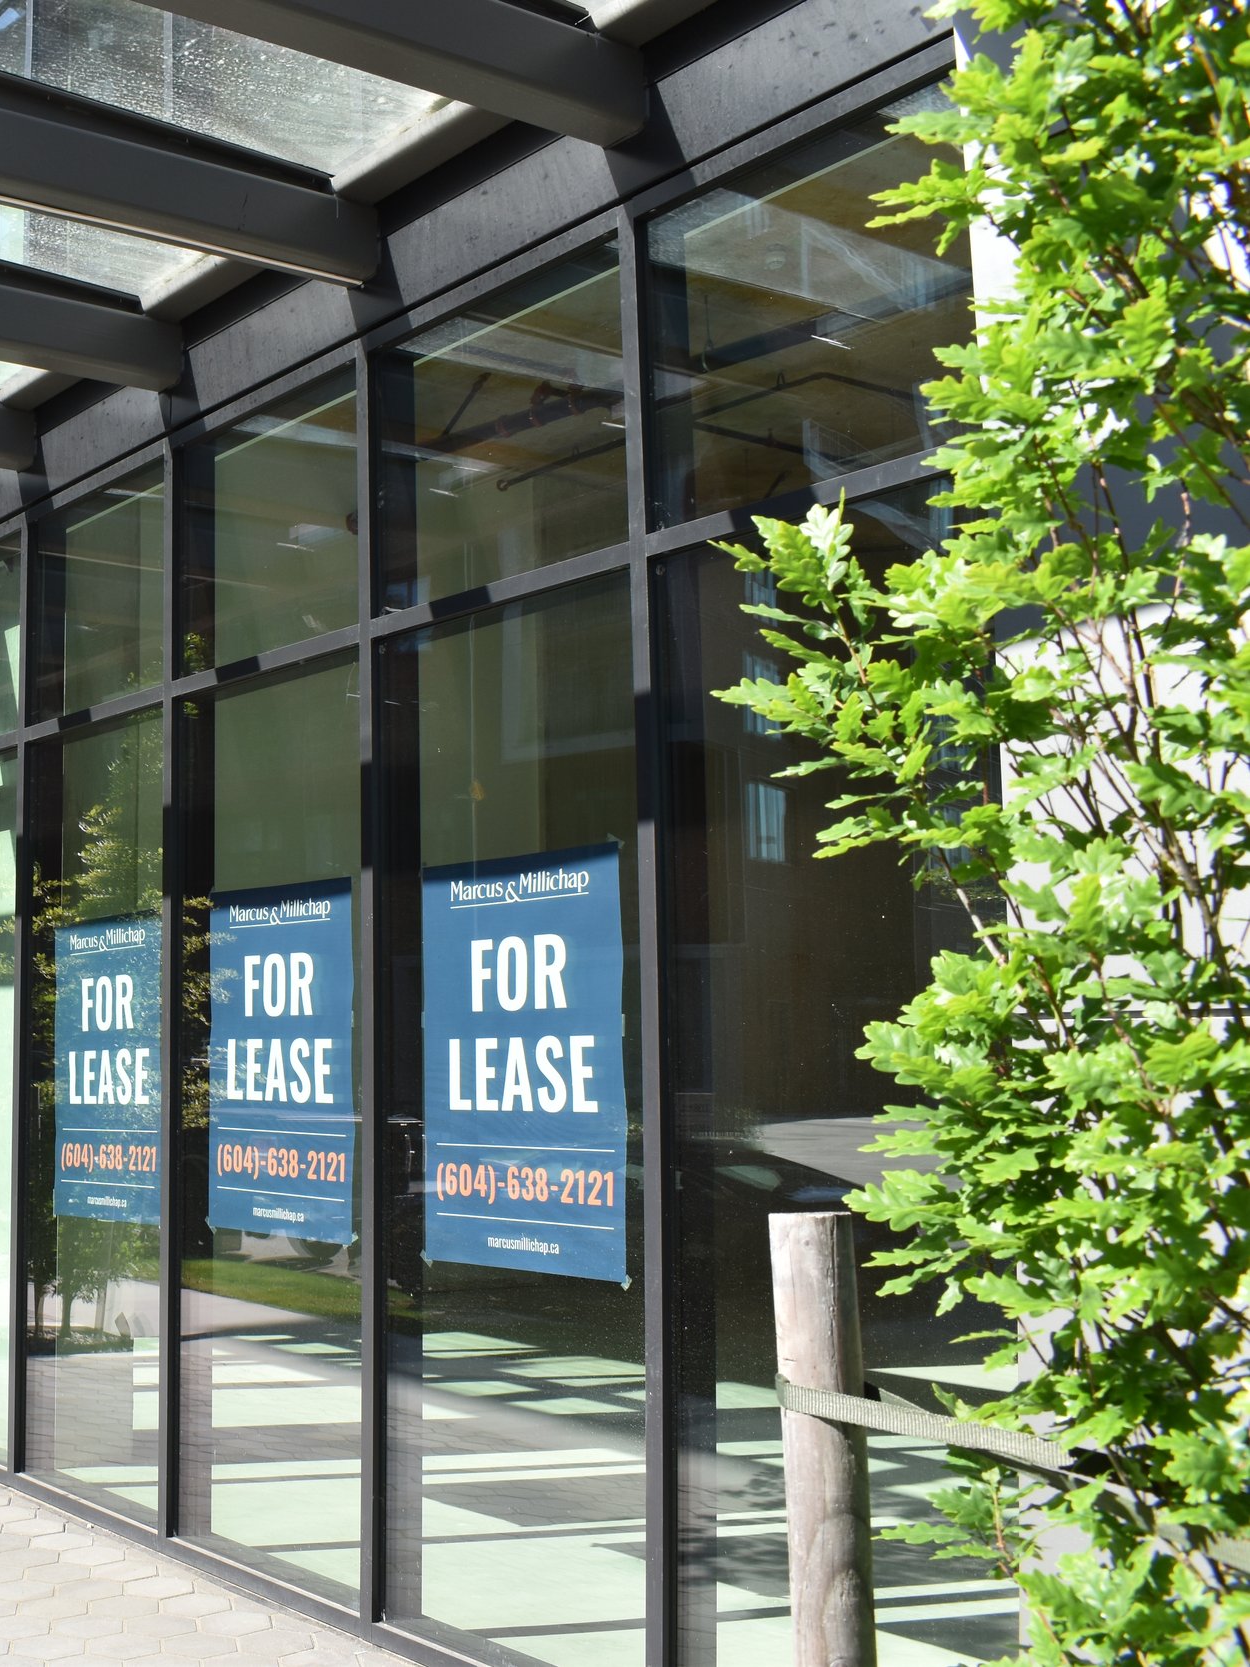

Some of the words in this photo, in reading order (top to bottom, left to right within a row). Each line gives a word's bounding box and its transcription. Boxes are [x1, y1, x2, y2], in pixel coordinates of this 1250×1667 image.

[450, 880, 504, 902] Marcus
[505, 881, 521, 903] &
[519, 867, 590, 895] Millichap
[229, 904, 269, 923] Marcus
[269, 906, 281, 925] &
[280, 897, 331, 919] Millichap
[69, 934, 99, 951] Marcus
[98, 935, 108, 952] &
[105, 926, 146, 946] Millichap
[244, 952, 314, 1017] FOR
[470, 933, 568, 1012] FOR
[81, 974, 135, 1032] FOR
[68, 1047, 150, 1105] LEASE
[226, 1037, 334, 1104] LEASE
[448, 1034, 599, 1113] LEASE
[61, 1142, 157, 1173] (604)-638-2121
[217, 1143, 346, 1183] (604)-638-2121
[436, 1162, 615, 1207] (604)-638-2121
[252, 1206, 305, 1223] marcusmillichap.ca
[487, 1236, 560, 1255] marcusmillichap.ca
